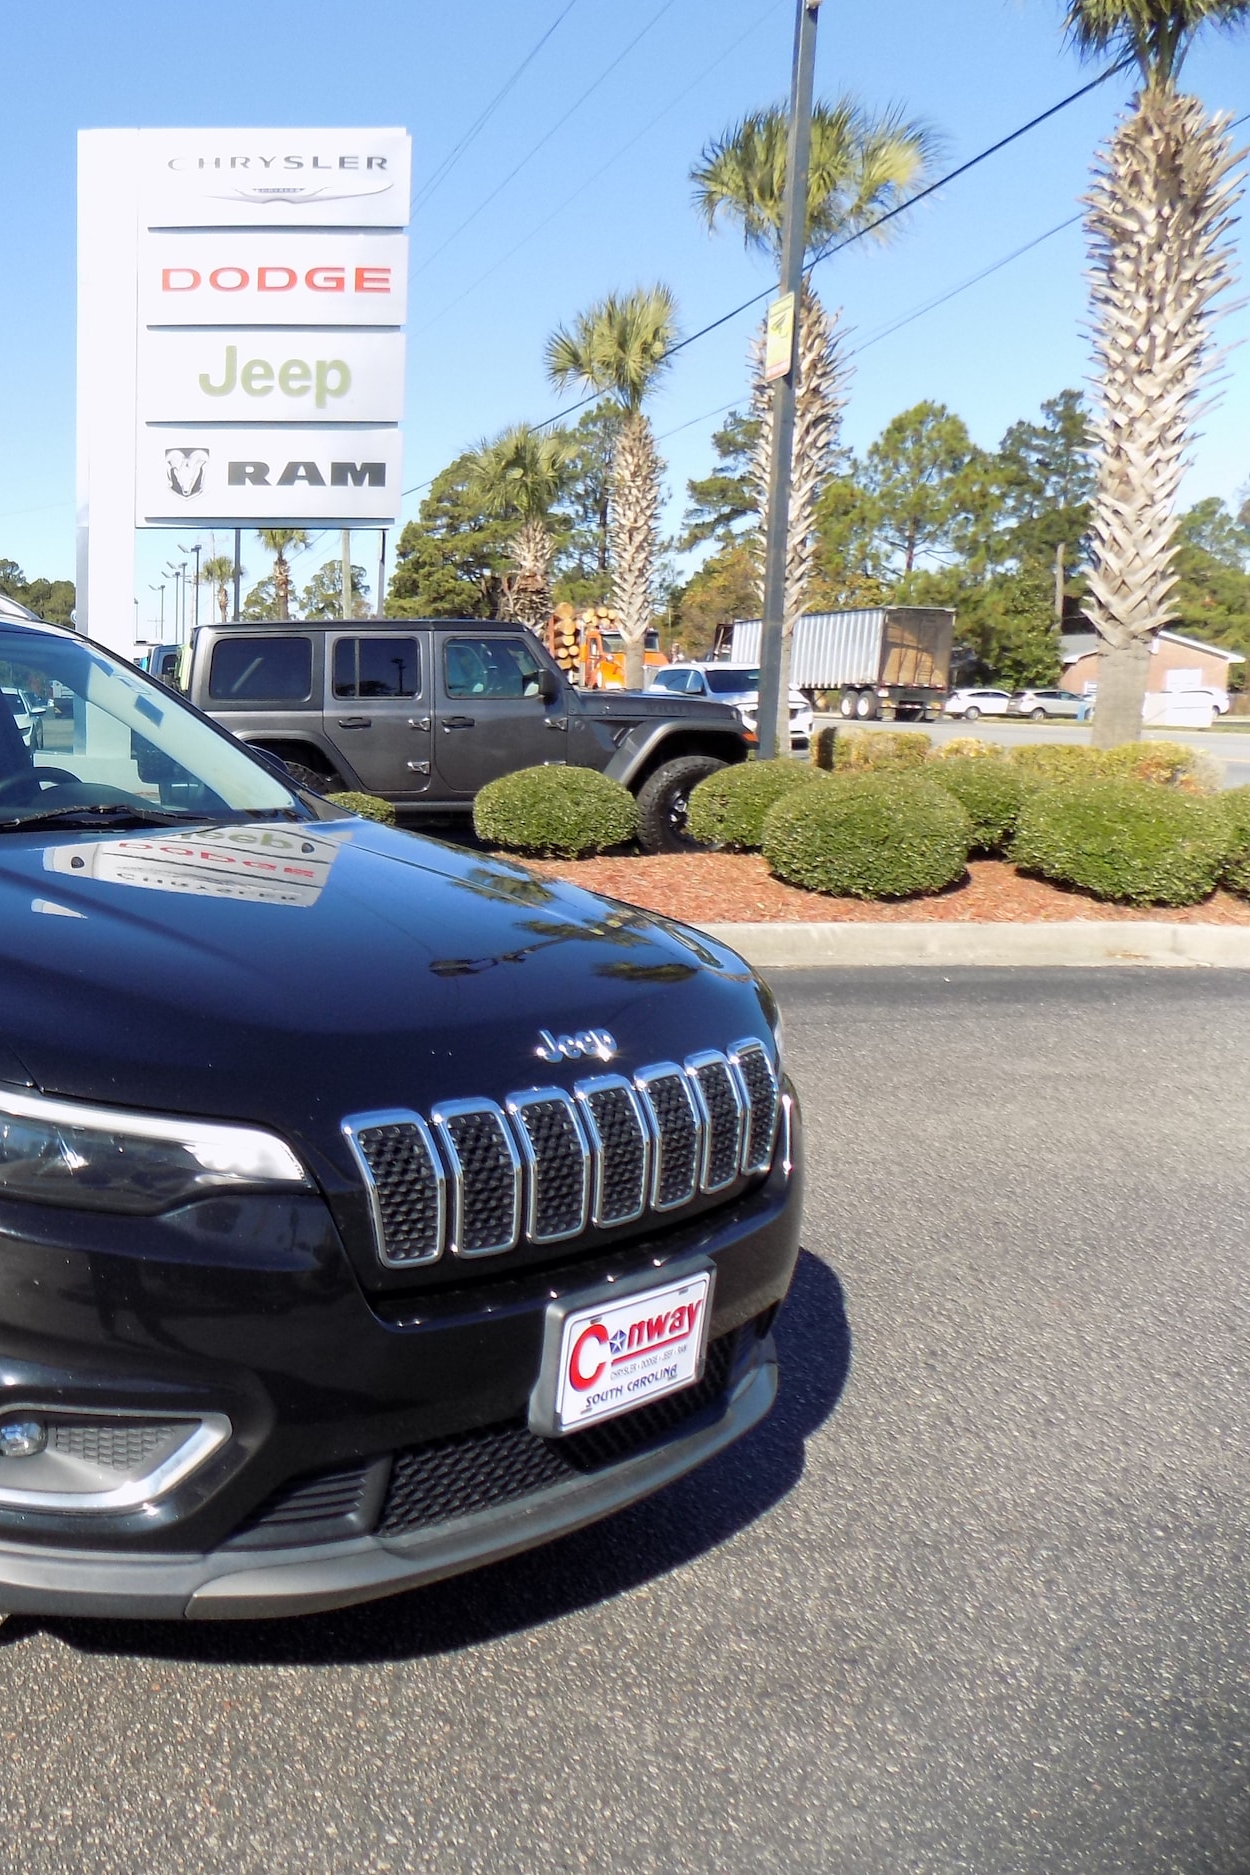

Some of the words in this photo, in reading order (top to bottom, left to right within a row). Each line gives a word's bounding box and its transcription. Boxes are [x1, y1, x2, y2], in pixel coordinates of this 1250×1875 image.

[167, 155, 388, 171] CHRYSLER
[162, 266, 391, 294] DODGE
[198, 345, 351, 409] Jeep
[228, 461, 386, 488] RAM
[535, 1028, 617, 1063] Jeep
[585, 1385, 623, 1408] SOUTH
[627, 1363, 678, 1393] CAROLINA
